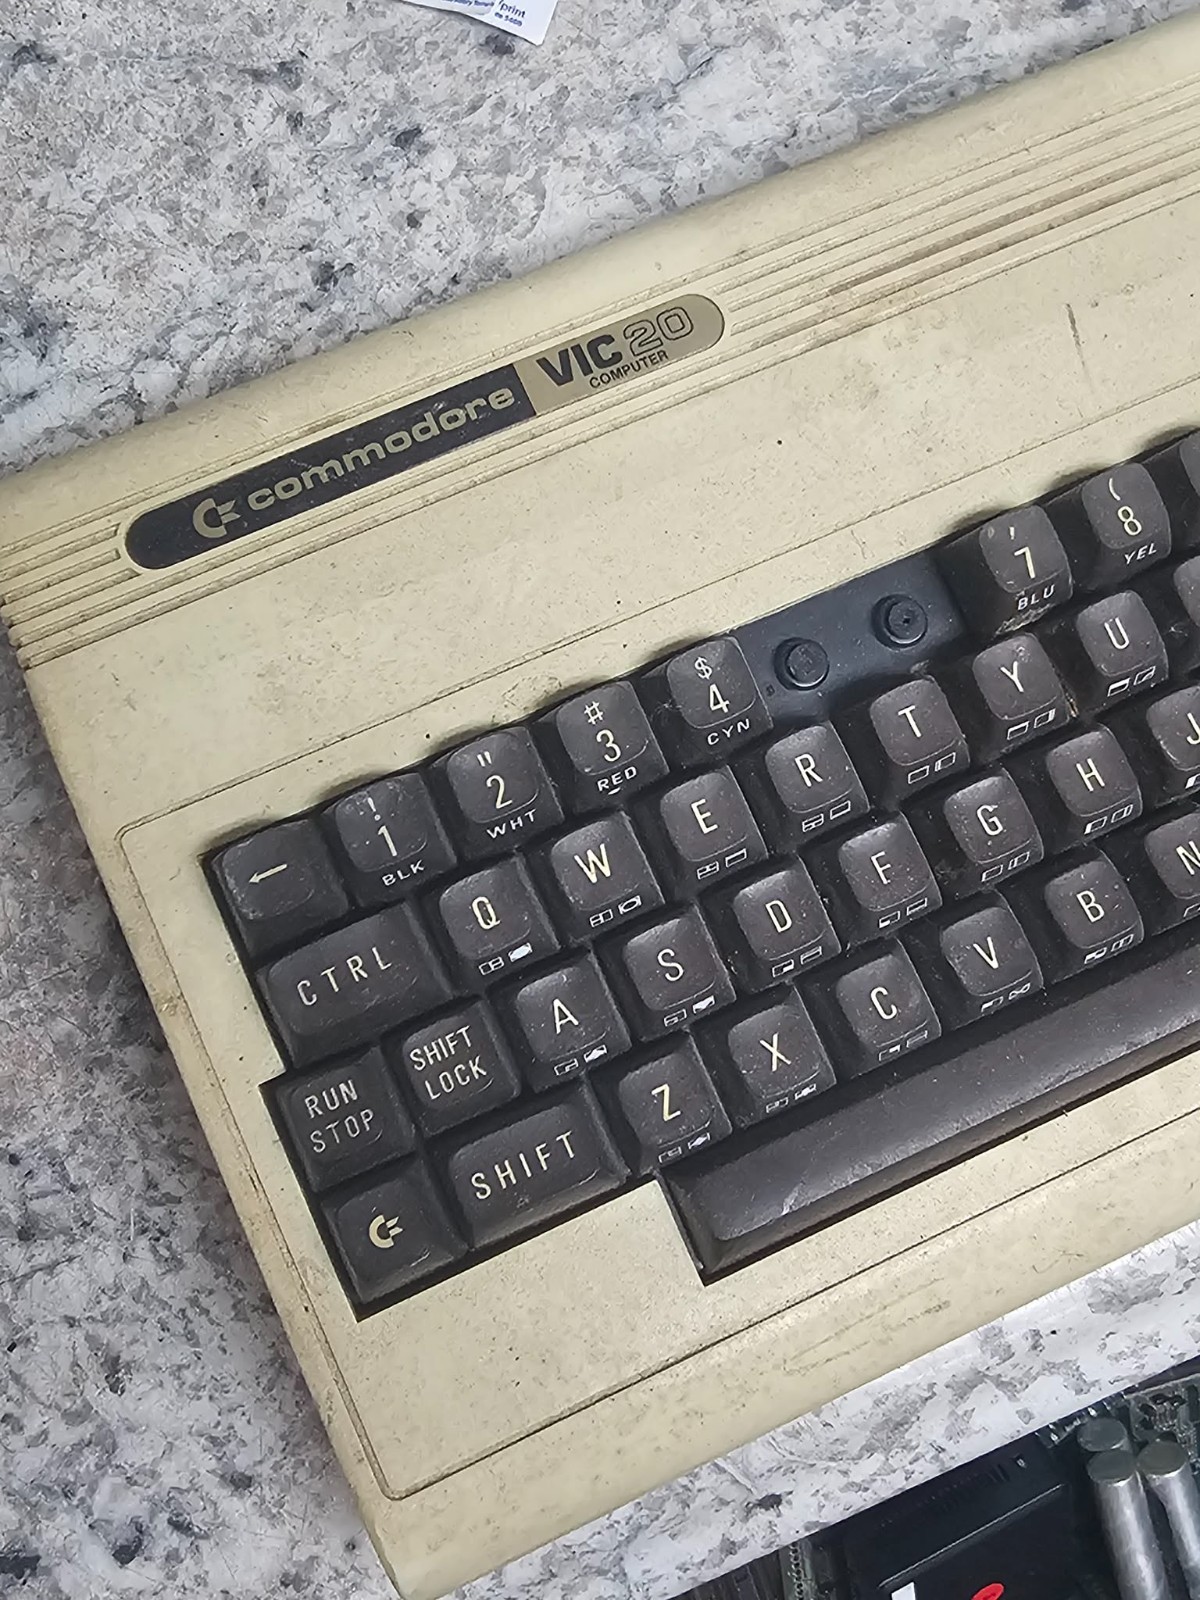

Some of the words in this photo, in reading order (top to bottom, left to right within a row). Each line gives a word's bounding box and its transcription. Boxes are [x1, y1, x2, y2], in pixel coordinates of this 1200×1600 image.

[536, 334, 623, 387] VIC
[623, 306, 694, 357] 20
[589, 349, 669, 389] COMPUTER
[247, 386, 516, 512] commodore
[1117, 505, 1142, 536] 8
[1014, 546, 1036, 579] 7
[1124, 543, 1157, 565] YEL
[1017, 584, 1055, 610] BLU
[1104, 617, 1130, 650] U
[1000, 660, 1024, 693] Y
[709, 683, 730, 713] 4
[707, 718, 750, 745] CYN
[897, 705, 922, 738] T
[596, 729, 621, 762] 3
[597, 766, 637, 791] RED
[794, 753, 823, 787] R
[1076, 758, 1106, 792] H
[486, 775, 513, 809] 2
[486, 808, 537, 839] WHT
[691, 798, 718, 834] E
[976, 804, 1004, 836] G
[377, 825, 398, 857] 1
[382, 860, 424, 886] BLK
[573, 843, 611, 884] W
[870, 850, 892, 885] F
[471, 896, 501, 930] Q
[765, 900, 793, 933] D
[1076, 890, 1105, 923] B
[657, 948, 684, 982] S
[972, 936, 999, 969] V
[297, 947, 392, 1006] CTRL
[553, 998, 579, 1035] A
[870, 986, 898, 1020] C
[409, 1025, 472, 1072] SHIFT
[759, 1032, 792, 1072] X
[424, 1055, 487, 1100] LOCK
[304, 1079, 358, 1119] RUN
[651, 1083, 681, 1122] Z
[309, 1108, 374, 1153] STOP
[471, 1130, 575, 1200] SHIFT
